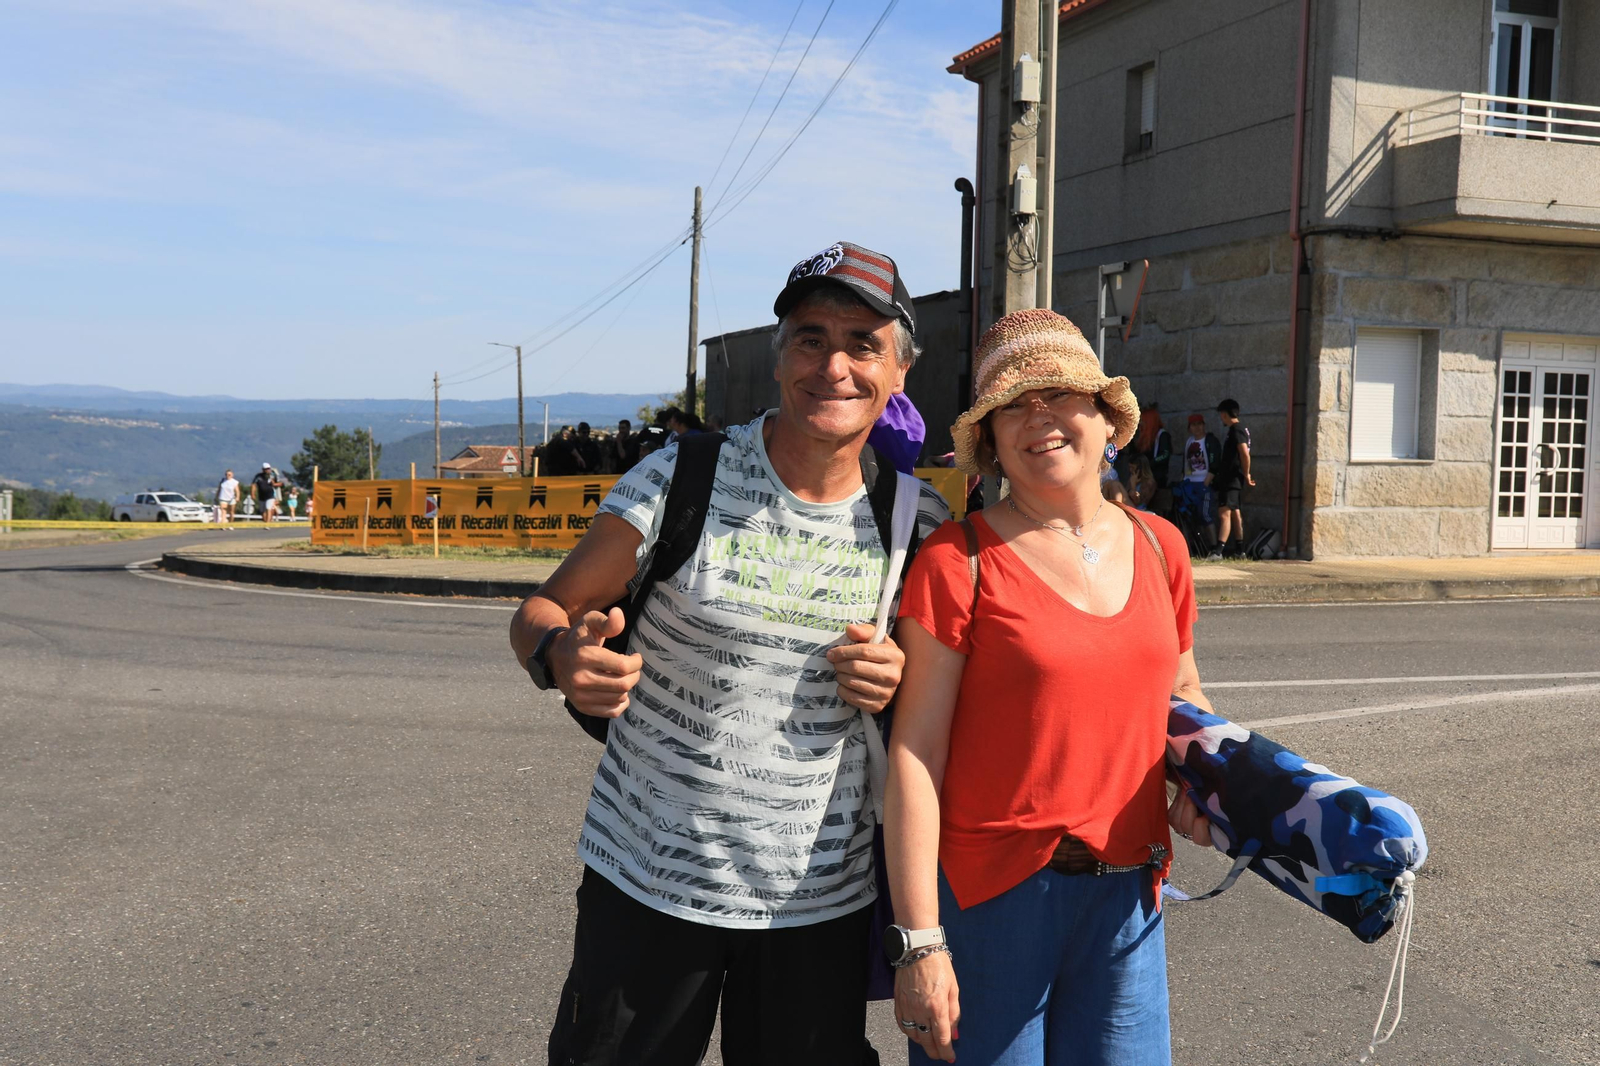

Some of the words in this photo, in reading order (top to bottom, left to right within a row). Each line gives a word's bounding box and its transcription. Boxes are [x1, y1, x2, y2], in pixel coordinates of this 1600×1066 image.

[320, 515, 359, 529] Recalvi
[461, 514, 508, 529] Recalvi
[514, 514, 562, 529] Recalvi
[711, 535, 829, 563] INVENTIVE
[749, 594, 773, 608] 8-10
[830, 606, 851, 618] 9-11
